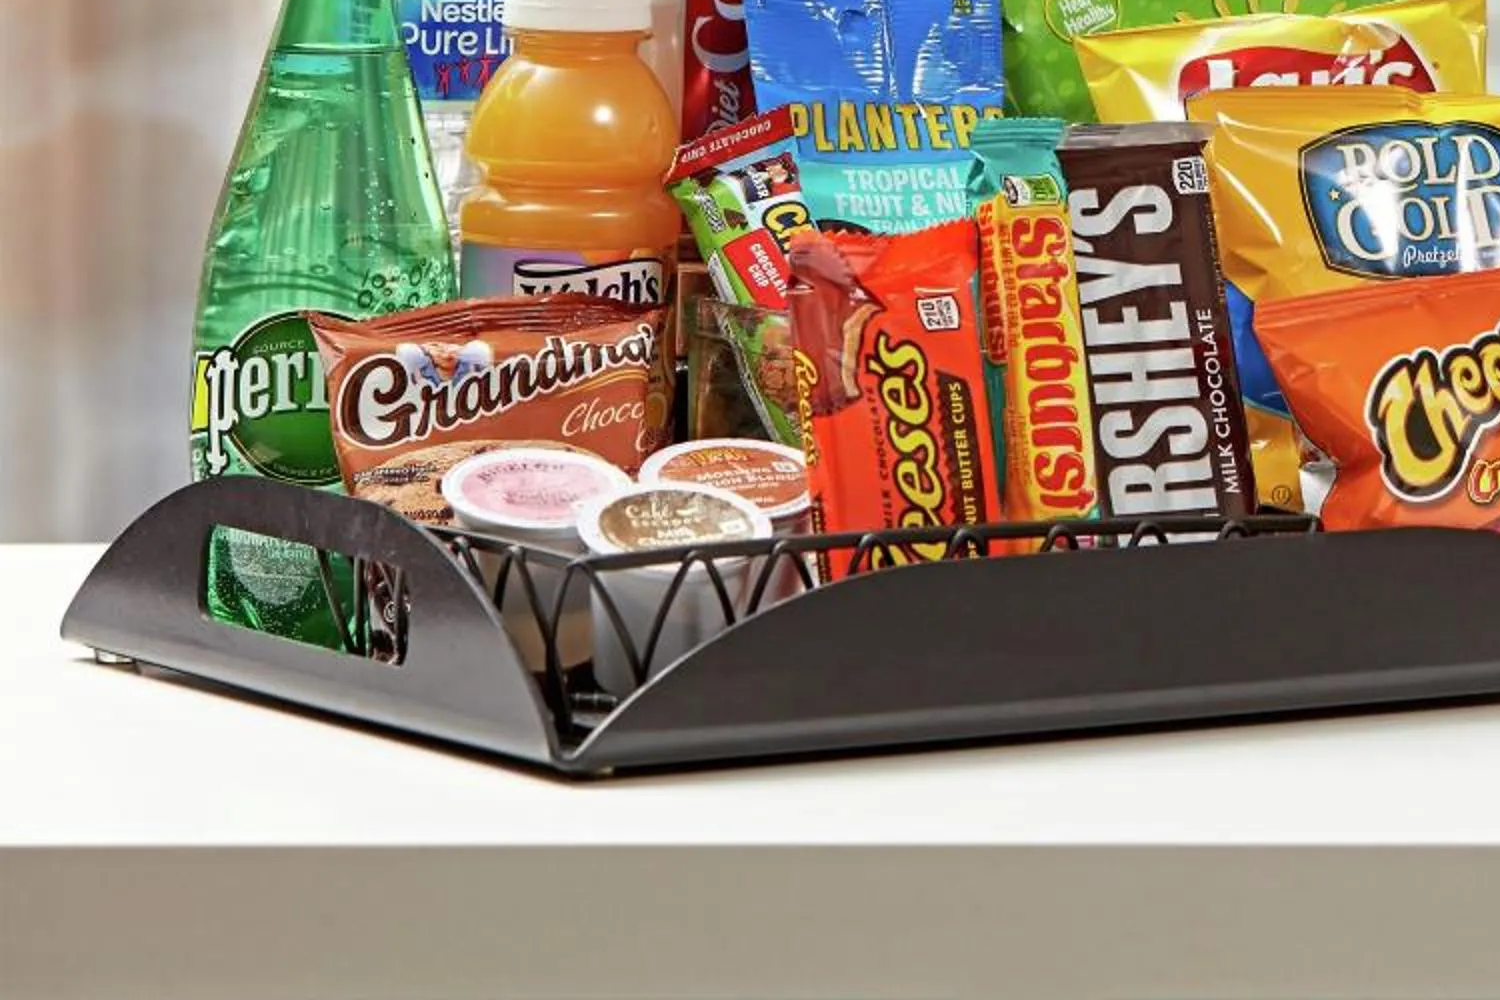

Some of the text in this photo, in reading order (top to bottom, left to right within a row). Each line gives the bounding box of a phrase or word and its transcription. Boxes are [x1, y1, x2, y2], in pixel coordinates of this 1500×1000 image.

[485, 26, 515, 56] Li
[842, 167, 967, 193] TROPICAL
[1177, 160, 1195, 191] 220
[1336, 133, 1500, 191] ROLD
[835, 191, 967, 218] FRUIT & NU
[1403, 243, 1464, 268] Pretzel
[519, 268, 661, 305] lch's
[254, 339, 306, 354] SOURCE
[1011, 215, 1097, 515] Starburst
[1068, 183, 1219, 517] RSHEY'S
[340, 324, 654, 450] Grandma'
[1196, 308, 1231, 438] CHOCOLATE
[205, 349, 330, 476] perr
[560, 397, 645, 438] Choco
[790, 347, 819, 467] Reese's
[948, 381, 966, 425] CUPS
[865, 385, 890, 481] CHOCOLATE
[953, 428, 974, 490] BUTTER
[1223, 442, 1242, 494] MILK
